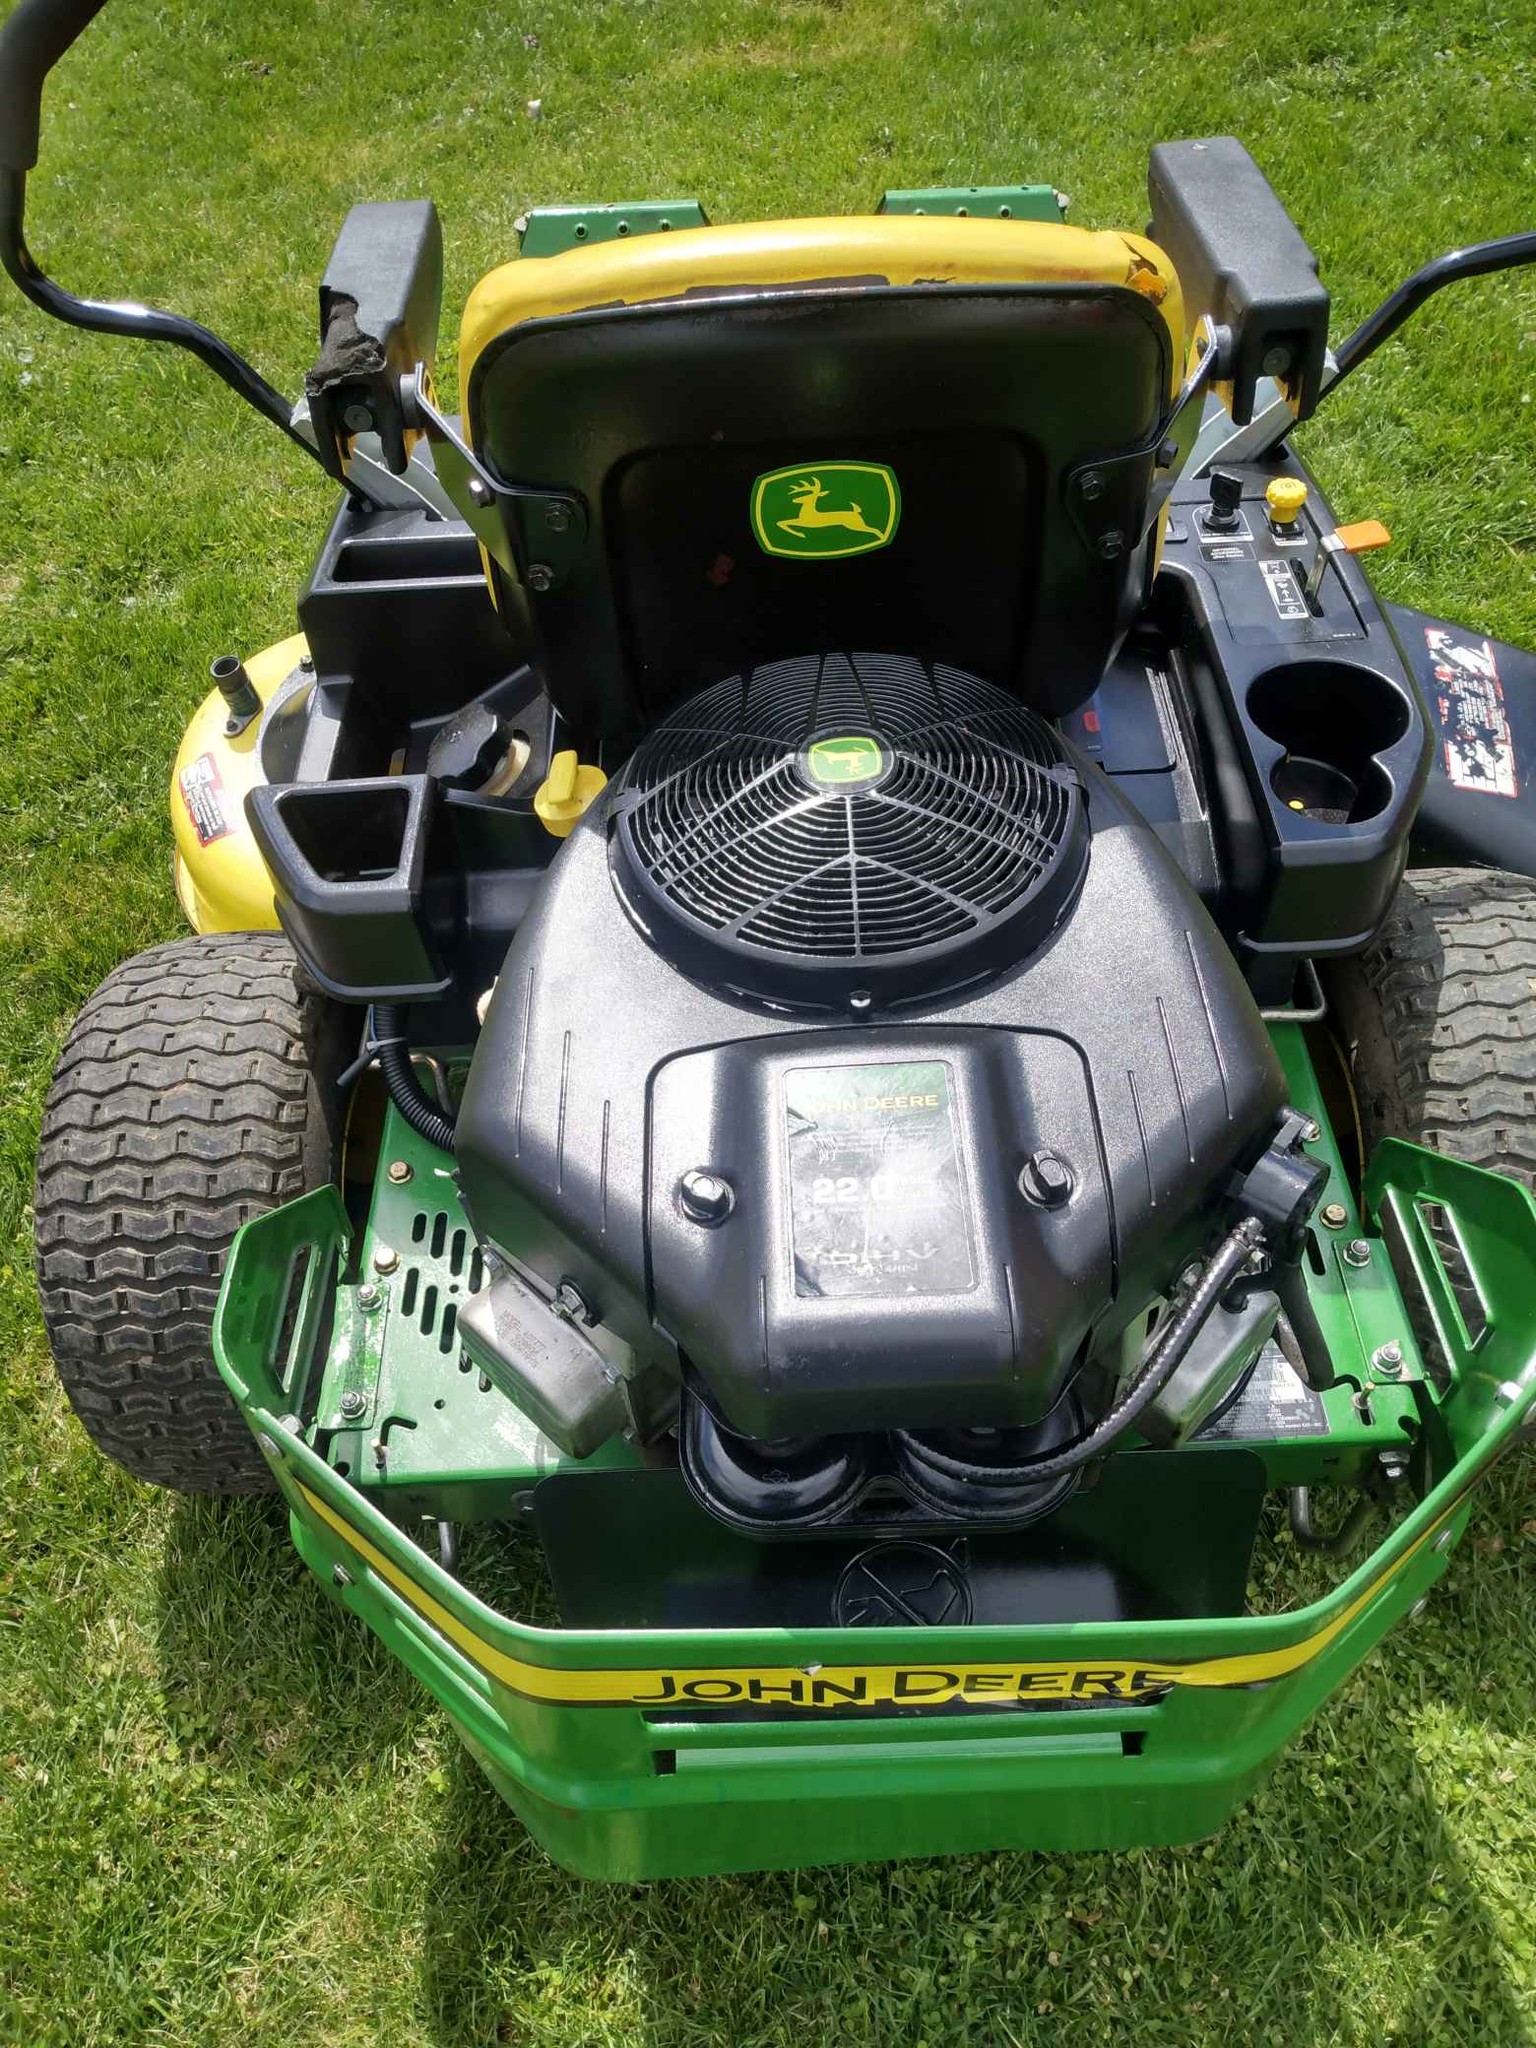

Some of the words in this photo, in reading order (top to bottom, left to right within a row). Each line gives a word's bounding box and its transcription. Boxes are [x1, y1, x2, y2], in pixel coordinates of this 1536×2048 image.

[864, 1094, 939, 1110] DEERE
[632, 1676, 867, 1703] JOHN
[895, 1670, 1184, 1698] DEERE
